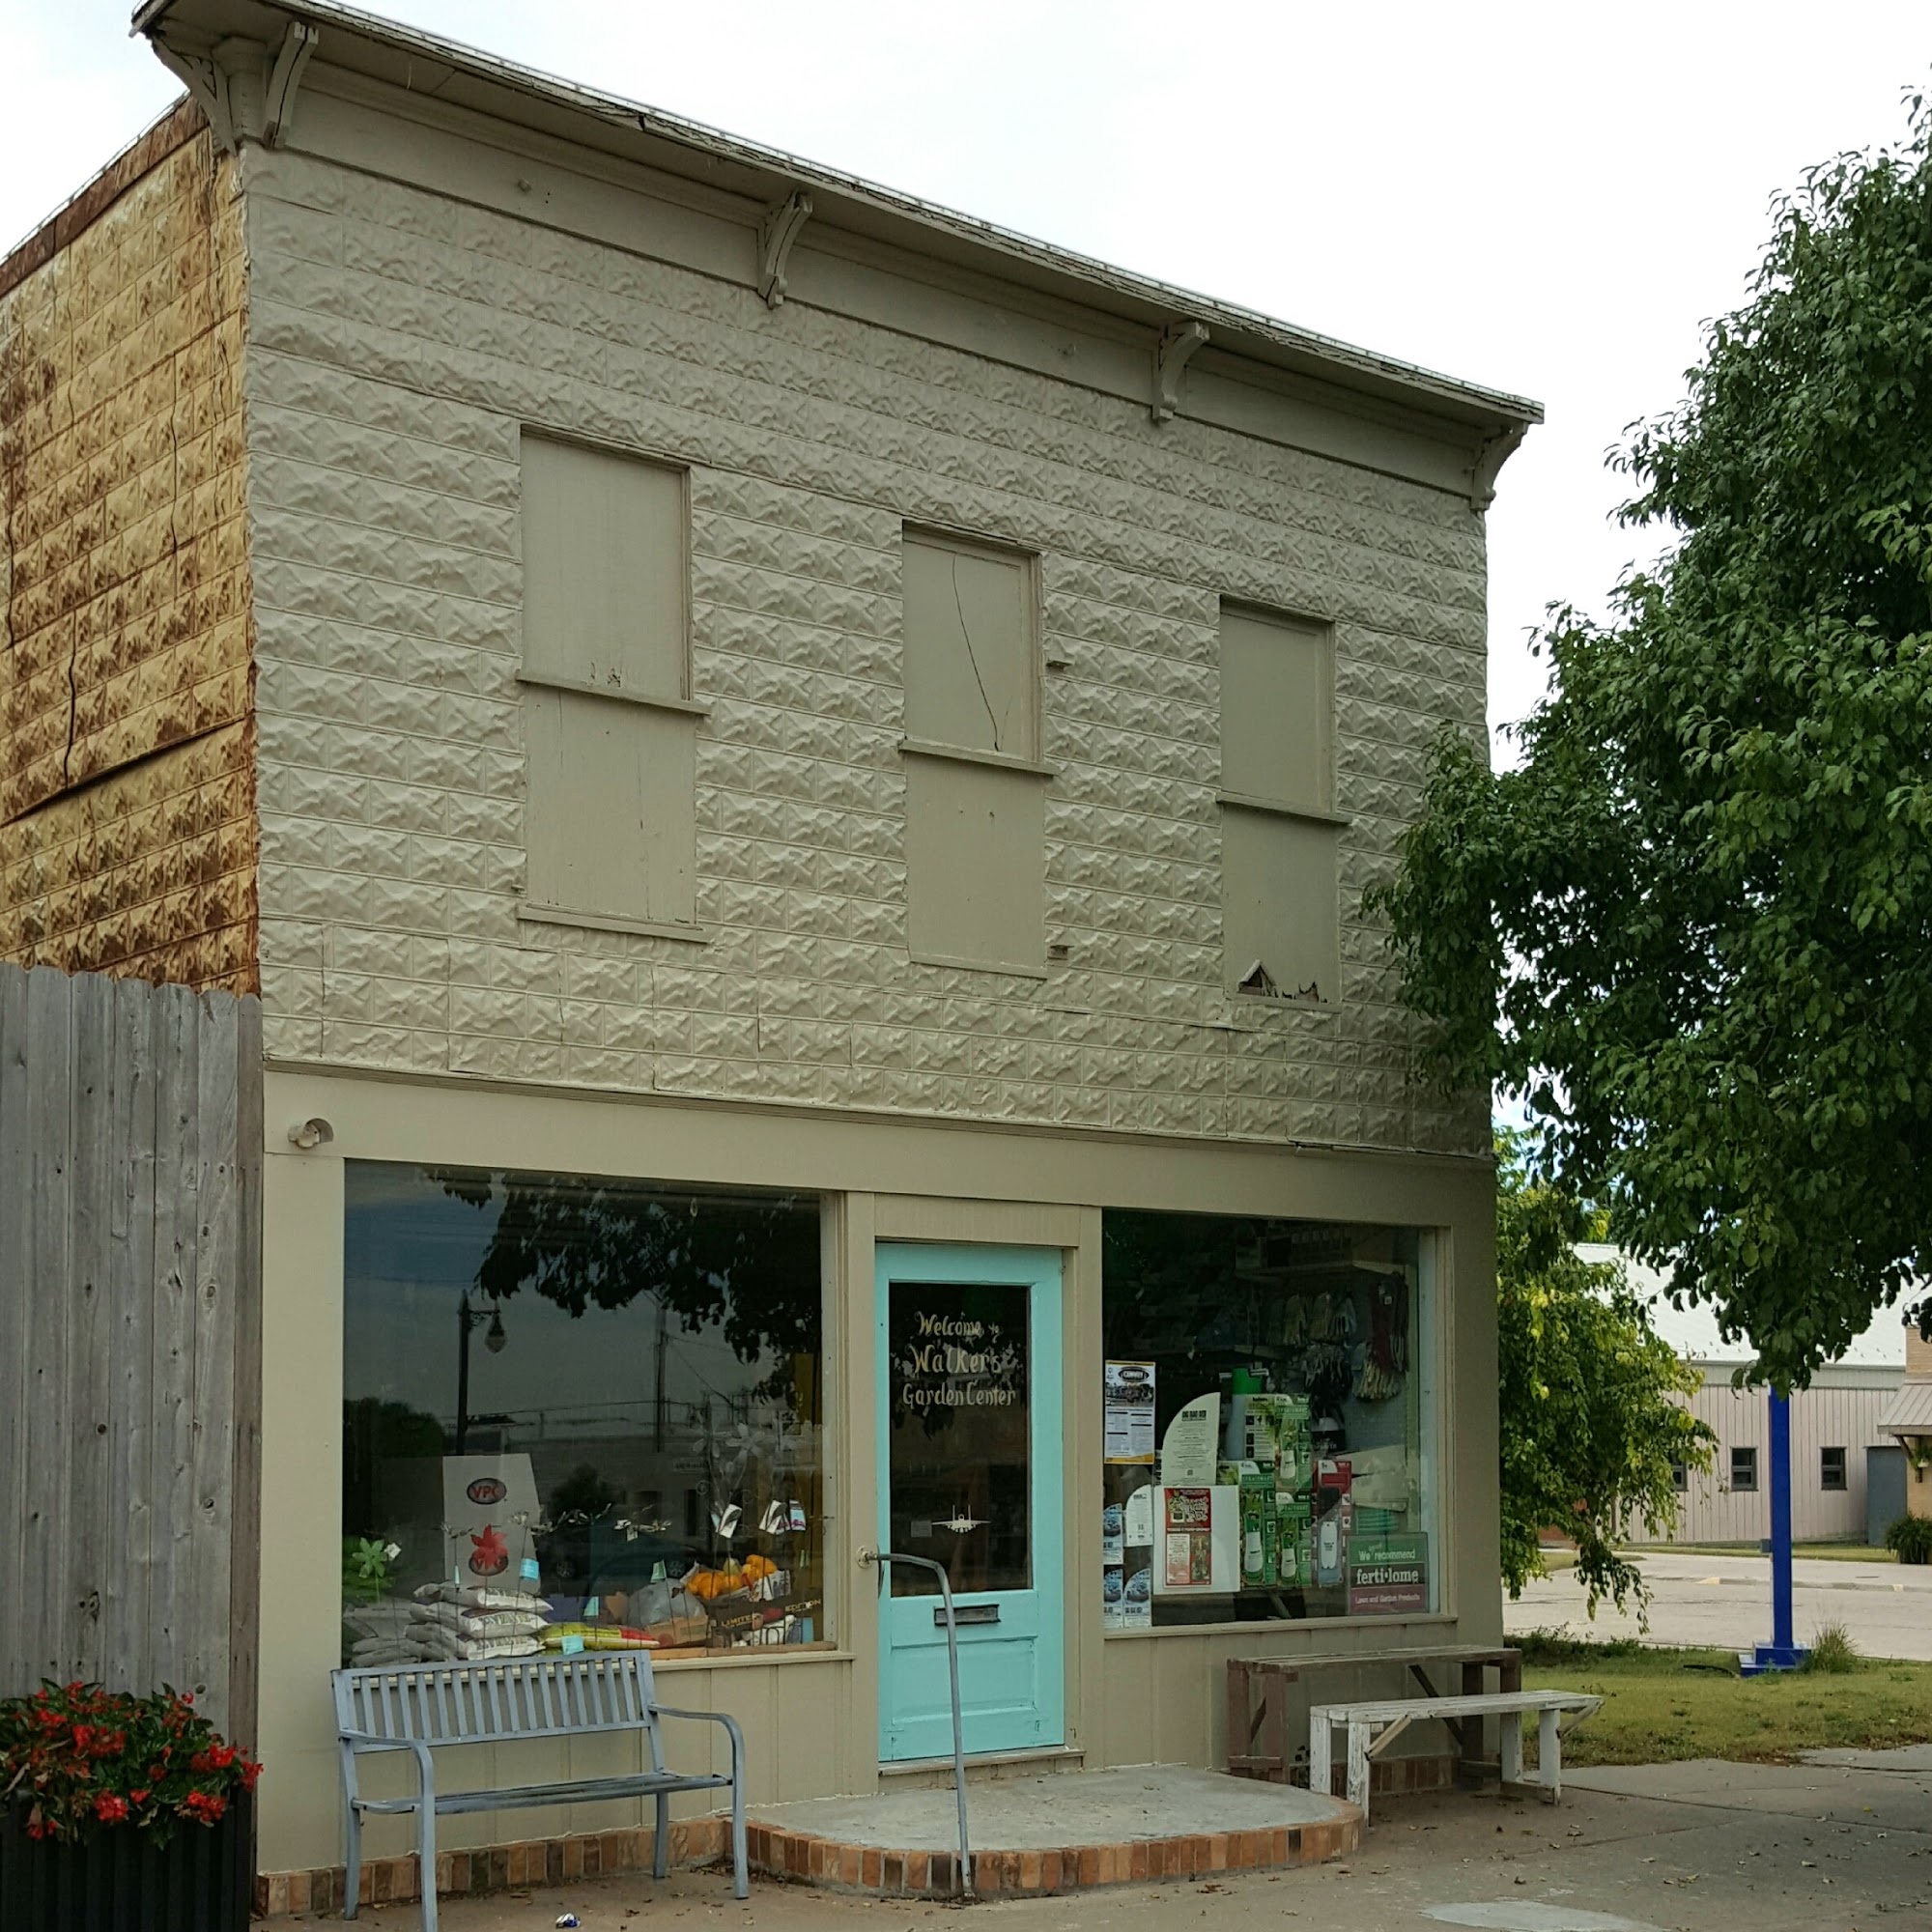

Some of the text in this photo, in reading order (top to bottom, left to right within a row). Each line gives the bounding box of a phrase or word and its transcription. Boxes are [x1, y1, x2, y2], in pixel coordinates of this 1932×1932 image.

[915, 1310, 981, 1337] Welcome
[902, 1379, 1015, 1409] Garden Center
[1358, 1548, 1416, 1561] We recommend
